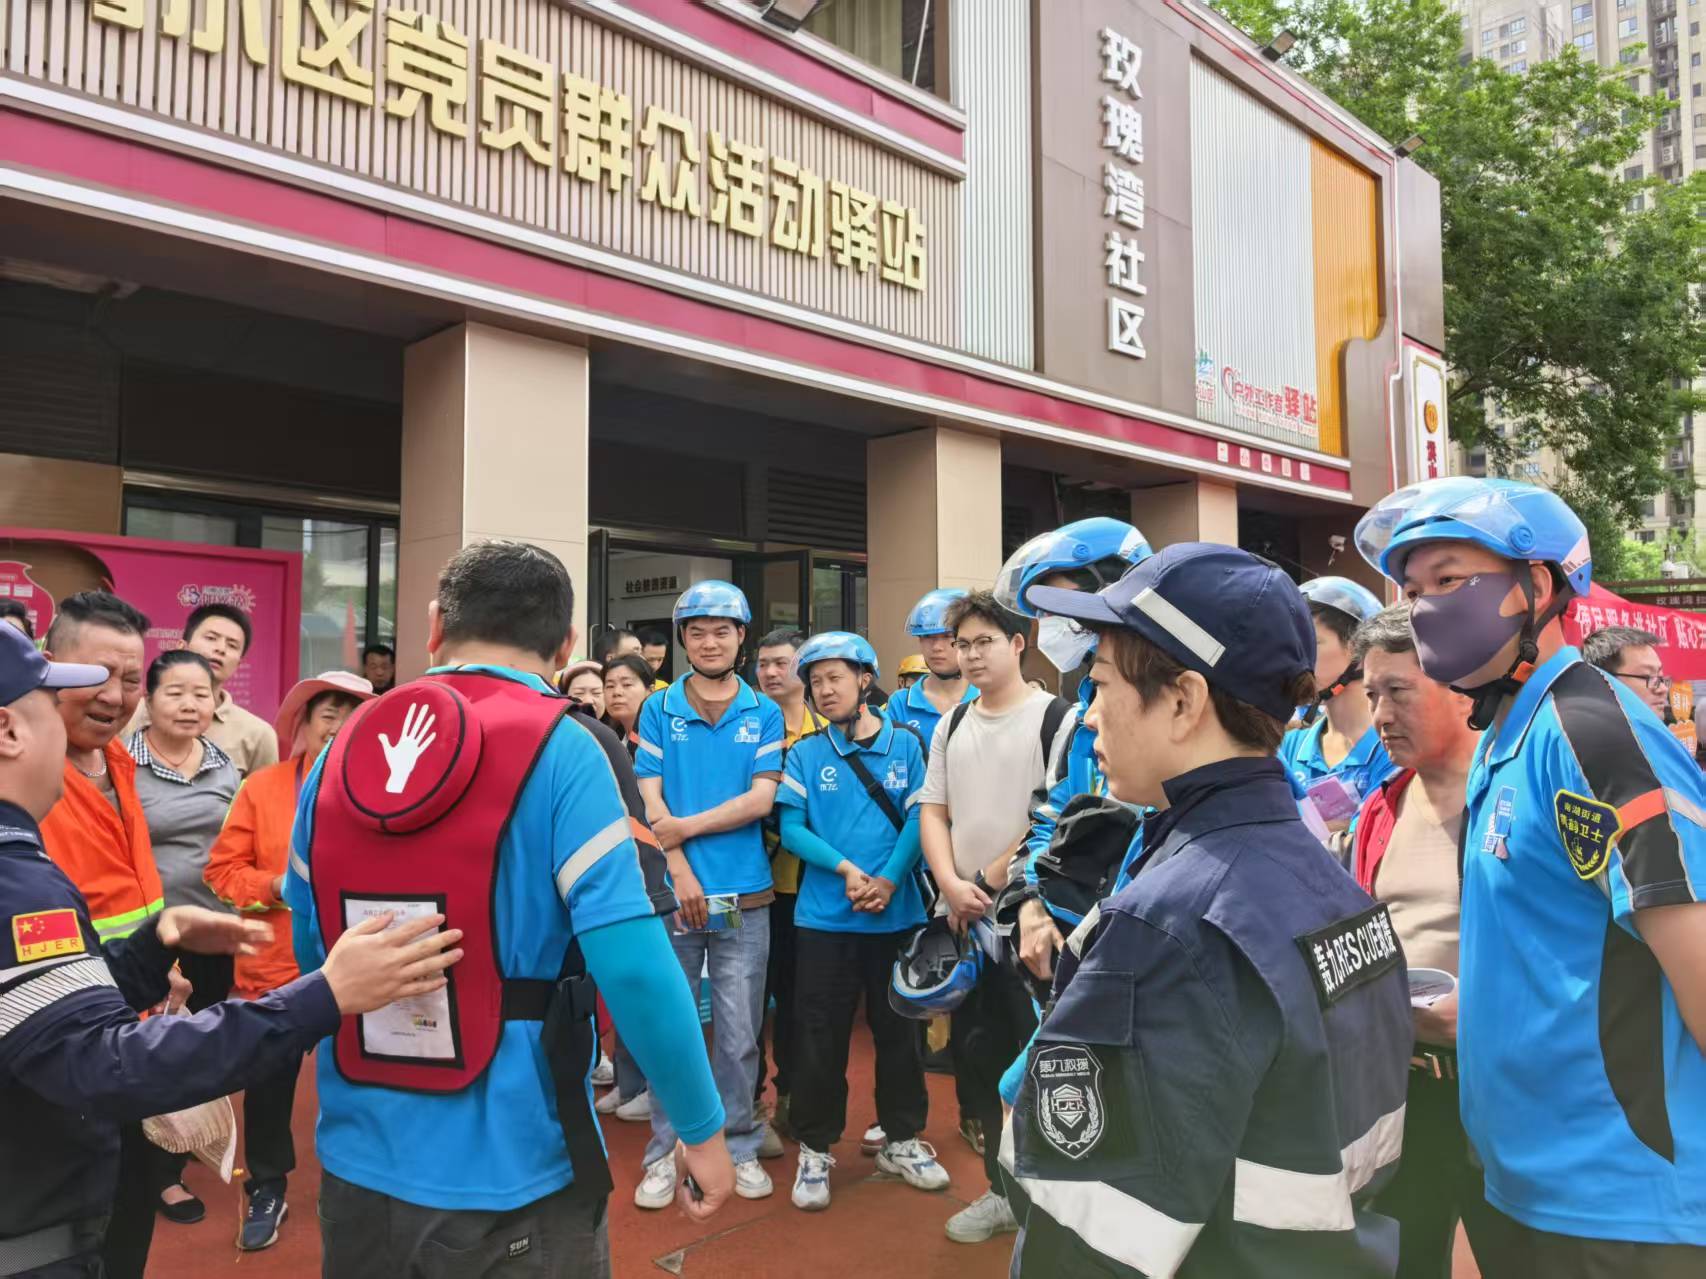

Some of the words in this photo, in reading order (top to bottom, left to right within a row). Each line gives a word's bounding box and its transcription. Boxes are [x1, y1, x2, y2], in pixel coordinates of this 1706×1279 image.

[1100, 26, 1147, 359] 玫瑰湾社区
[22, 939, 79, 957] HJER
